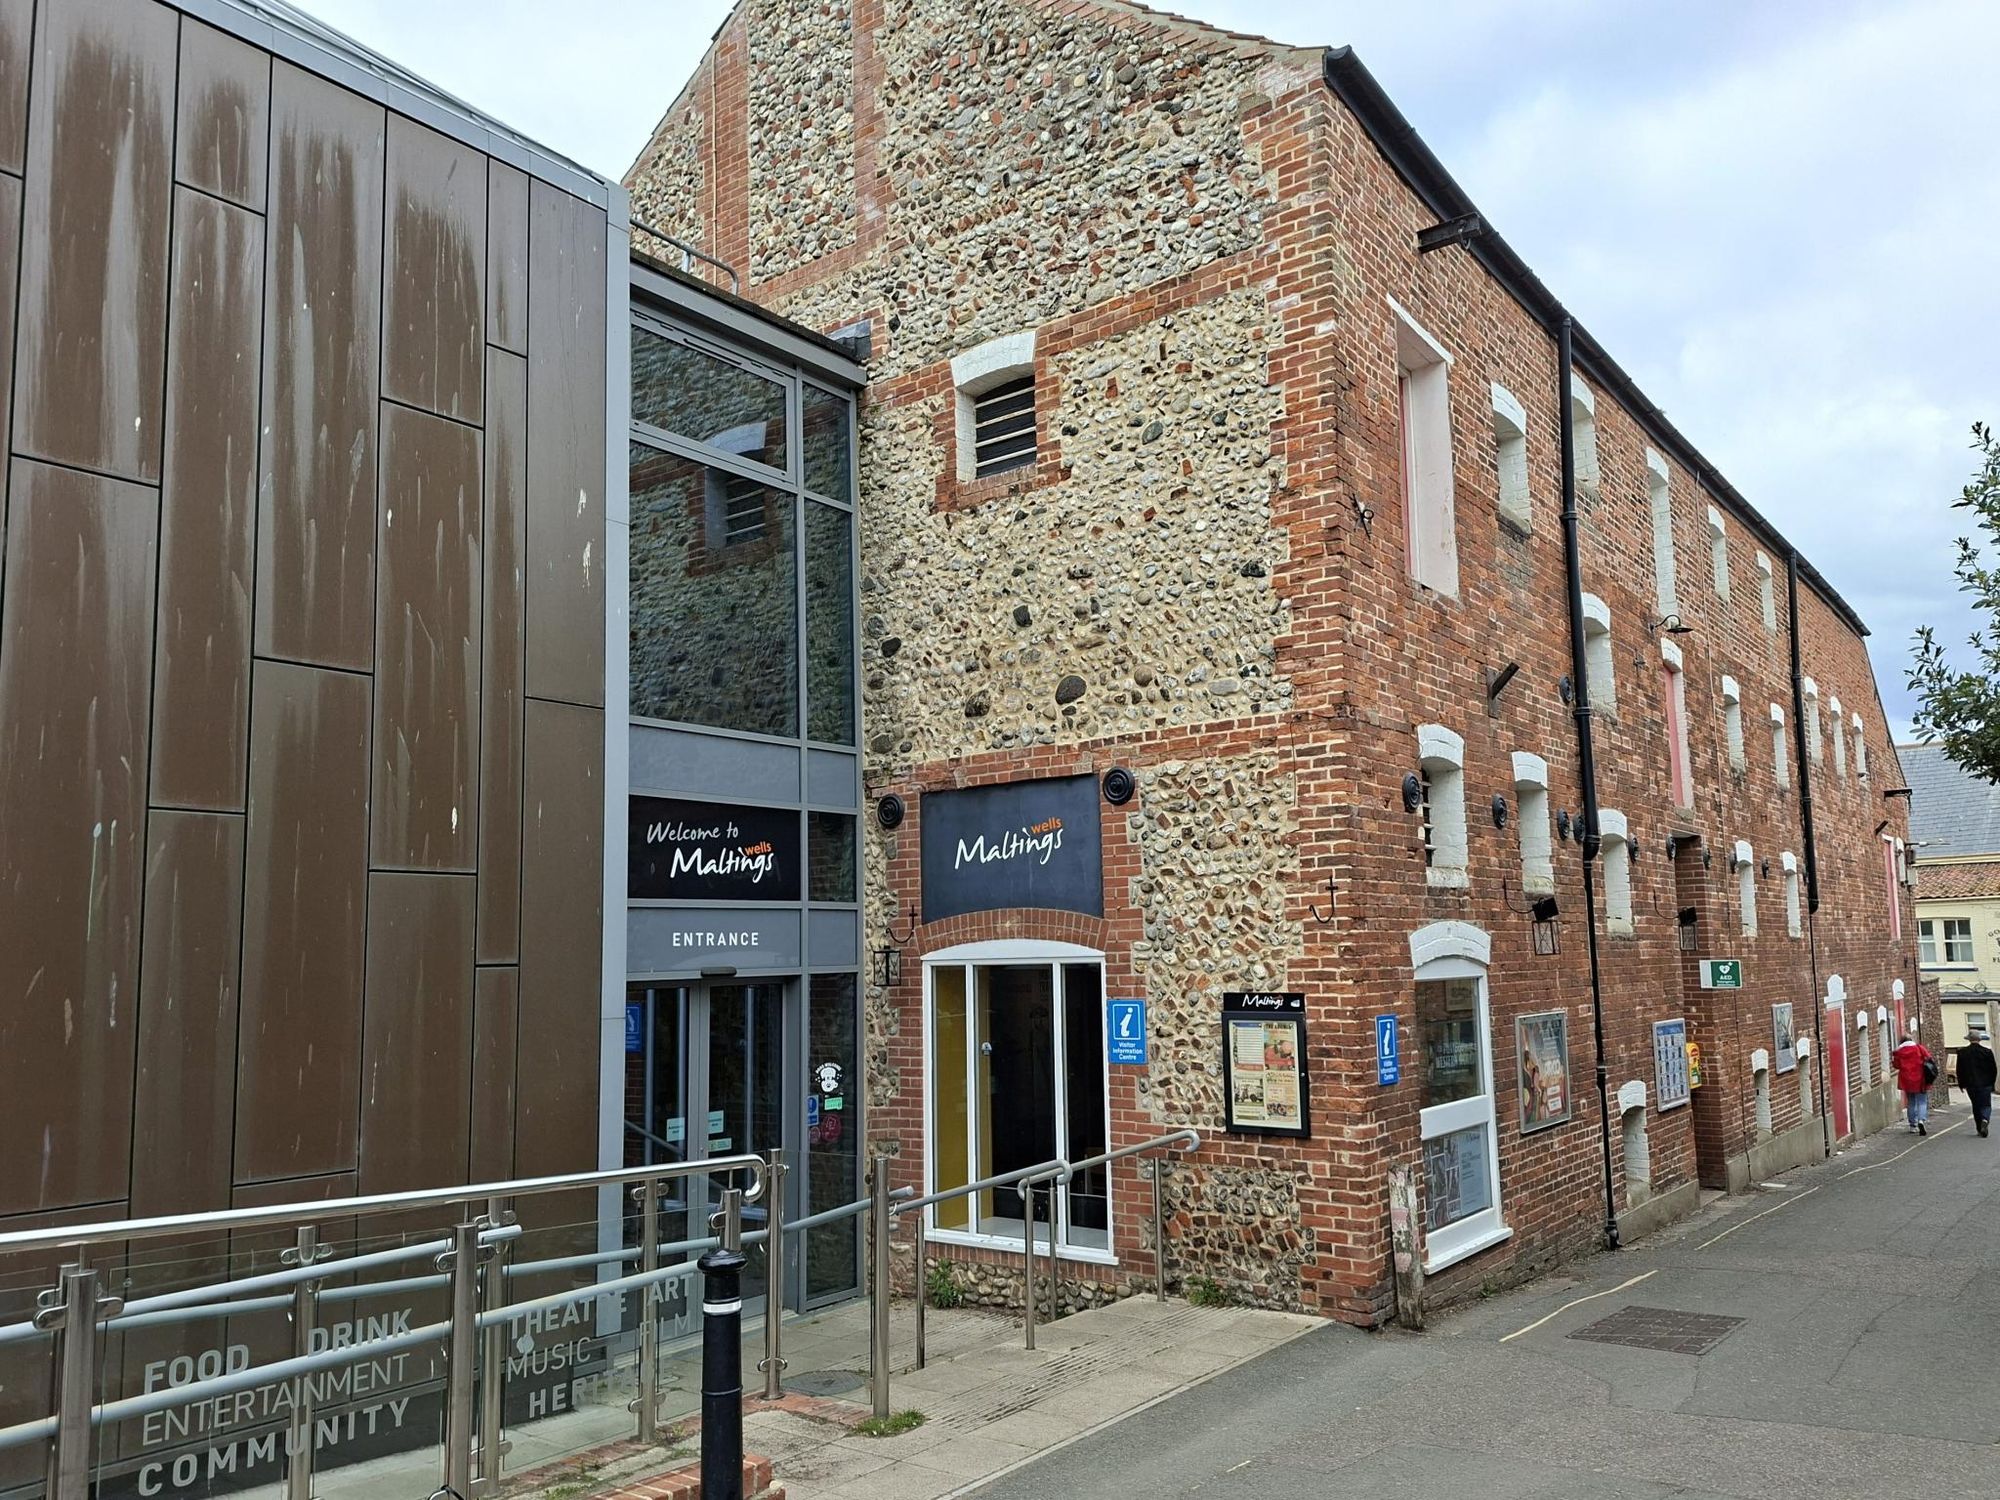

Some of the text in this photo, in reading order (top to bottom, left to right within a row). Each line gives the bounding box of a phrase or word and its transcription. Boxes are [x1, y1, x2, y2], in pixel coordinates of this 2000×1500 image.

[646, 821, 739, 844] Welcome to
[1030, 816, 1063, 835] wells
[669, 846, 775, 884] Maltings
[744, 841, 773, 856] wells
[954, 827, 1064, 870] Maltings
[672, 931, 760, 947] ENTRANCE
[1241, 993, 1284, 1010] Maltings
[1112, 1047, 1144, 1055] Information
[506, 1272, 695, 1340] THEATE ART
[143, 1308, 413, 1395] FOOD DRINK
[507, 1336, 592, 1383] MUSIC
[142, 1353, 411, 1447] ENTERTAINMENT
[138, 1397, 410, 1497] COMMUNITY
